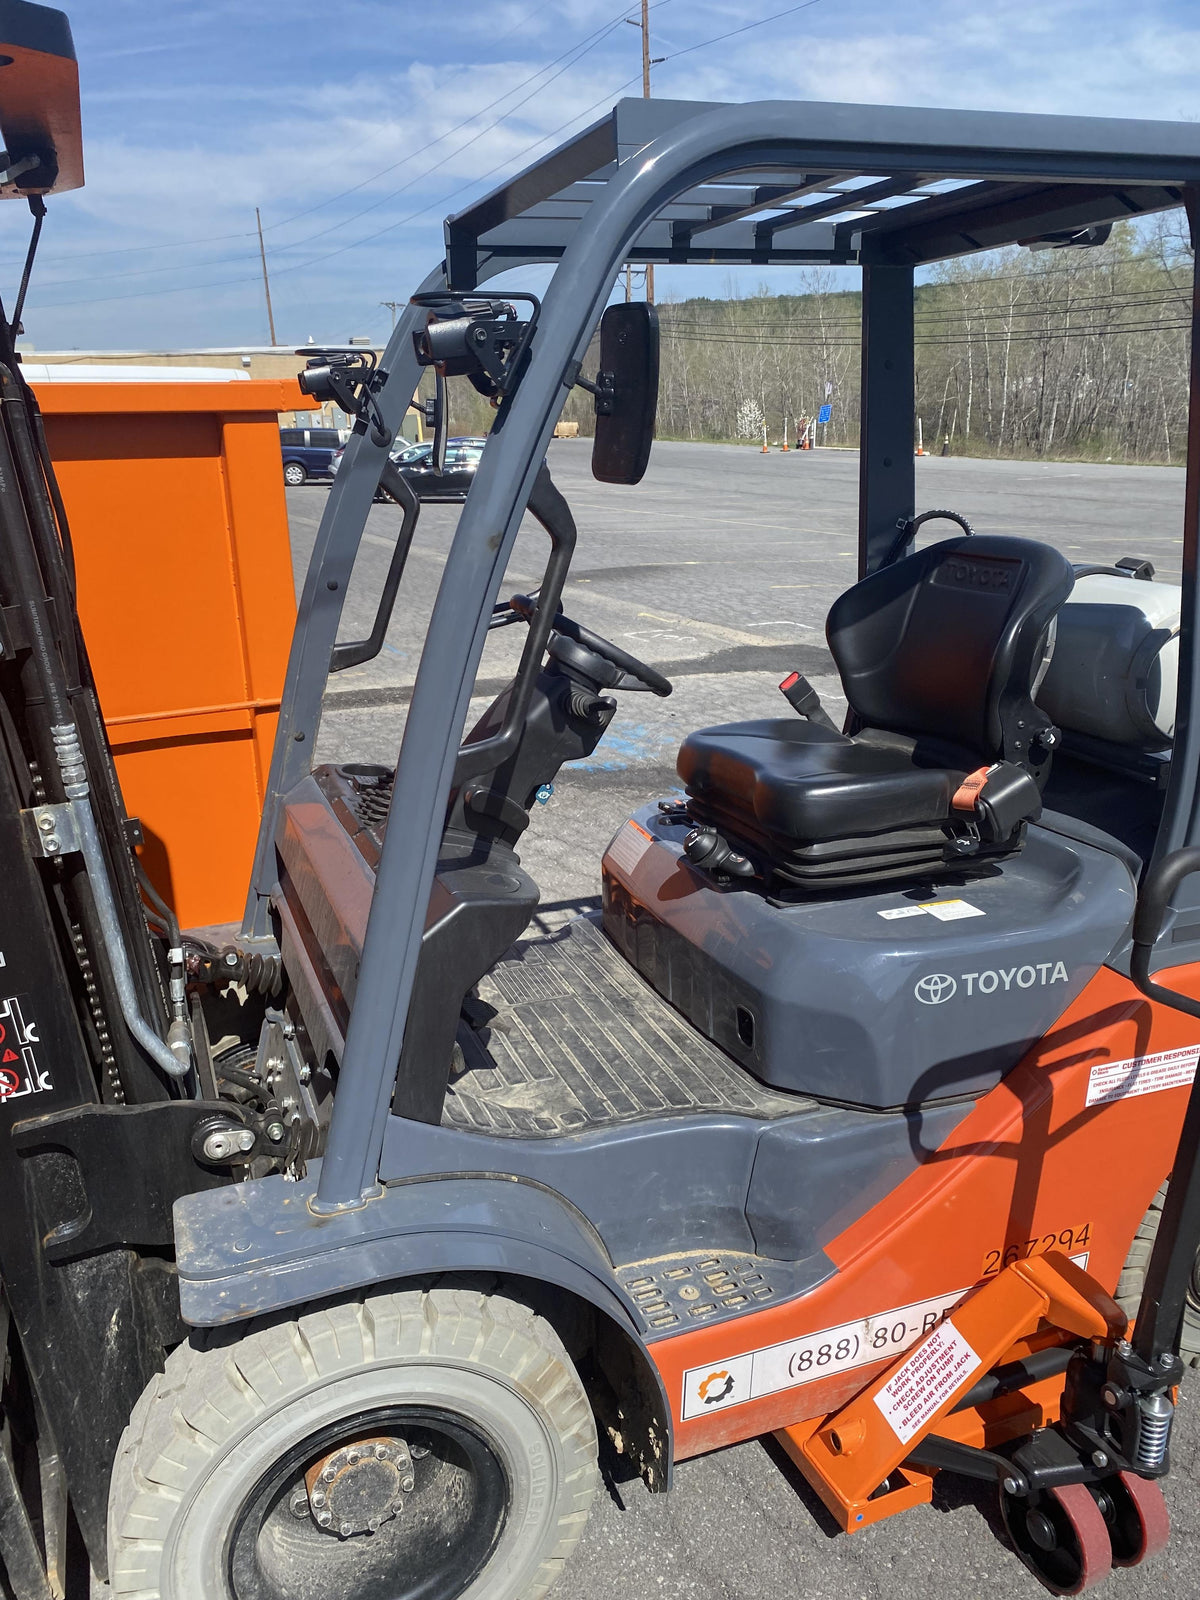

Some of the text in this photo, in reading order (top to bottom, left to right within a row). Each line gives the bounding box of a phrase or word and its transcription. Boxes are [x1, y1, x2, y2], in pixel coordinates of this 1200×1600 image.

[961, 961, 1069, 996] TOYOTA
[1122, 1056, 1162, 1070] CUSTOMER
[1130, 1072, 1146, 1080] LEVELS
[983, 1223, 1090, 1276] 267294
[788, 1335, 860, 1378] (888)
[886, 1332, 941, 1393] IF JACK DOES NOT
[891, 1341, 945, 1397] WORK PROPERLY:
[892, 1340, 958, 1411] CHECK ADJUSTMENT
[903, 1354, 954, 1411] SCREW ON PUMP
[902, 1352, 971, 1427] BLEED AIR FROM JACK
[912, 1370, 968, 1429] SEE MANUAL FOR DETAILS.
[526, 1440, 547, 1526] SOLIDEAL
